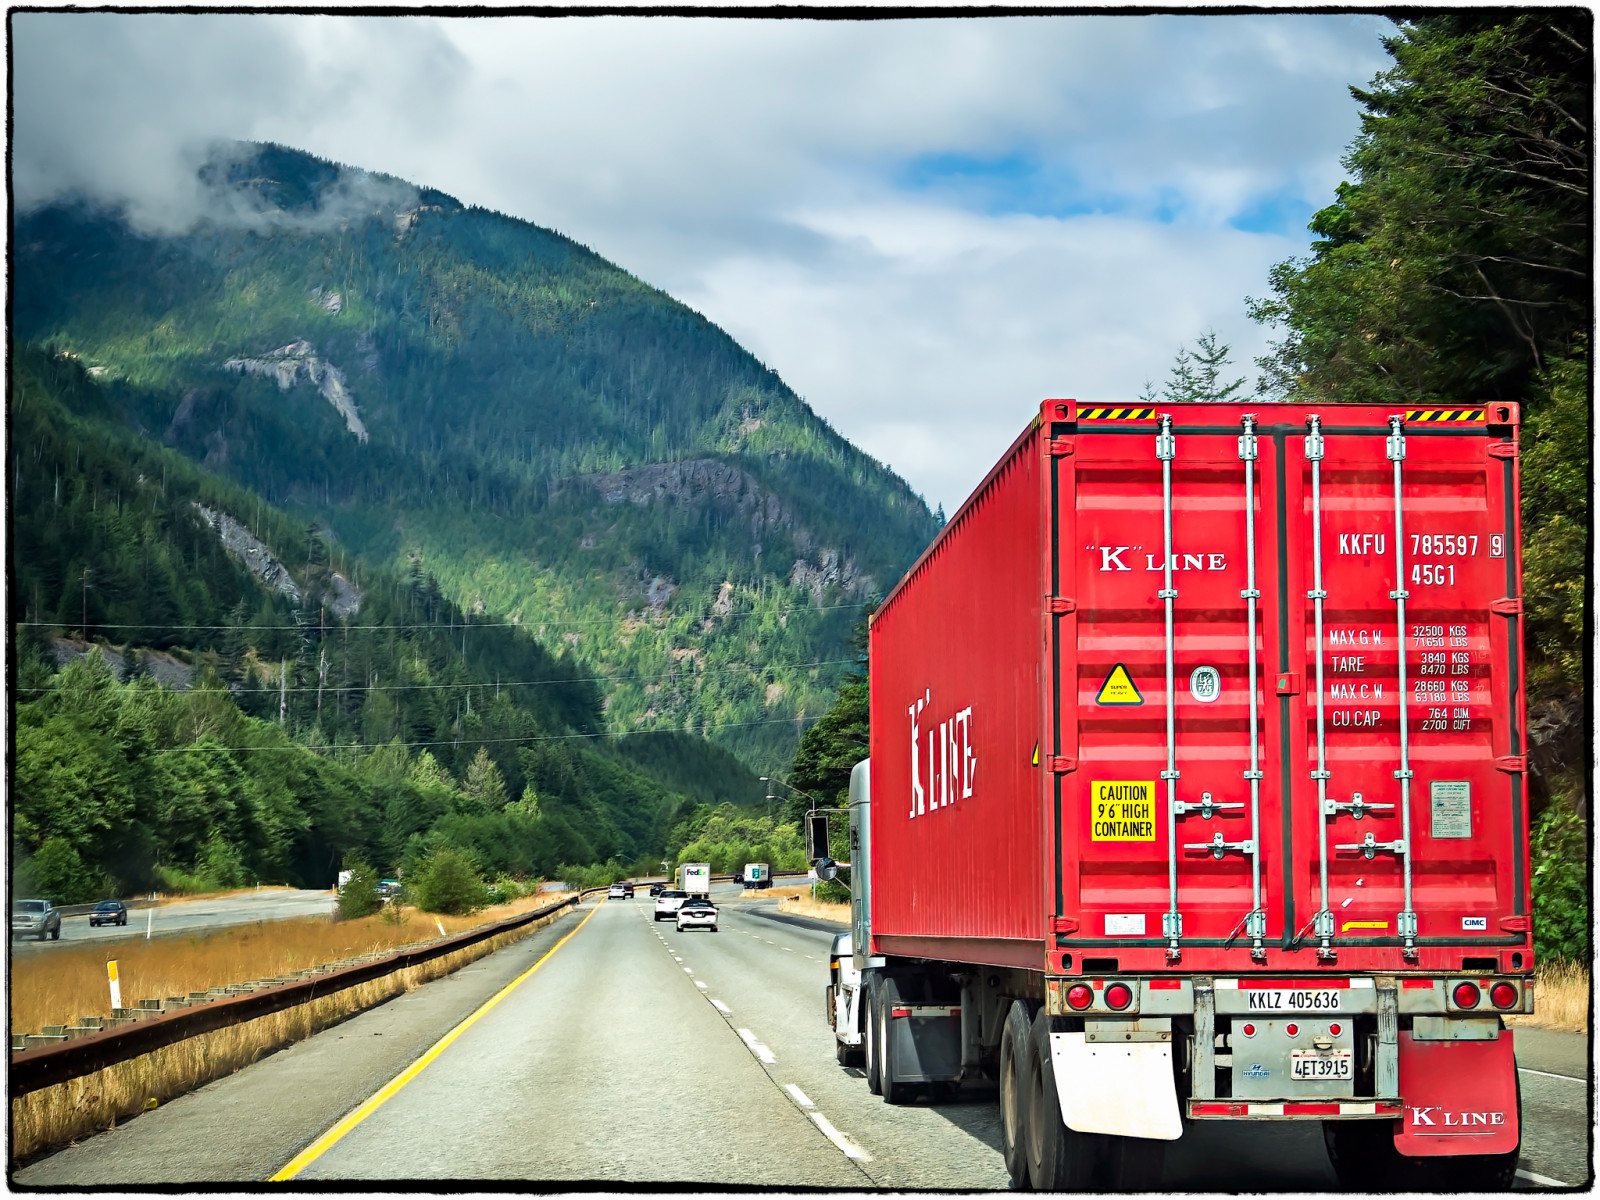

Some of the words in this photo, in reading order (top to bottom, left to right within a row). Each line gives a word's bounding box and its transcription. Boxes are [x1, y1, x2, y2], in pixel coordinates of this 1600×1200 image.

[1339, 533, 1385, 555] KKFU
[1410, 534, 1478, 556] 785597
[1491, 535, 1503, 556] 9
[1145, 554, 1227, 571] LINE
[1411, 564, 1455, 585] 45G1
[1449, 625, 1467, 637] KGS
[1450, 637, 1468, 647] LBS
[1331, 656, 1365, 672] TARE
[1451, 652, 1469, 663] KGS
[1451, 664, 1469, 675] LBS
[1451, 680, 1469, 692] KGS
[1452, 692, 1470, 702] LBS
[929, 706, 977, 811] LINE
[1100, 785, 1147, 800] CAUTION
[1122, 803, 1149, 818] HIGH
[1095, 821, 1152, 836] CONTAINER
[1249, 992, 1281, 1008] KKLZ
[1288, 992, 1339, 1008] 405636
[1295, 1060, 1348, 1076] 4ET3915
[1443, 1112, 1505, 1126] LINE
